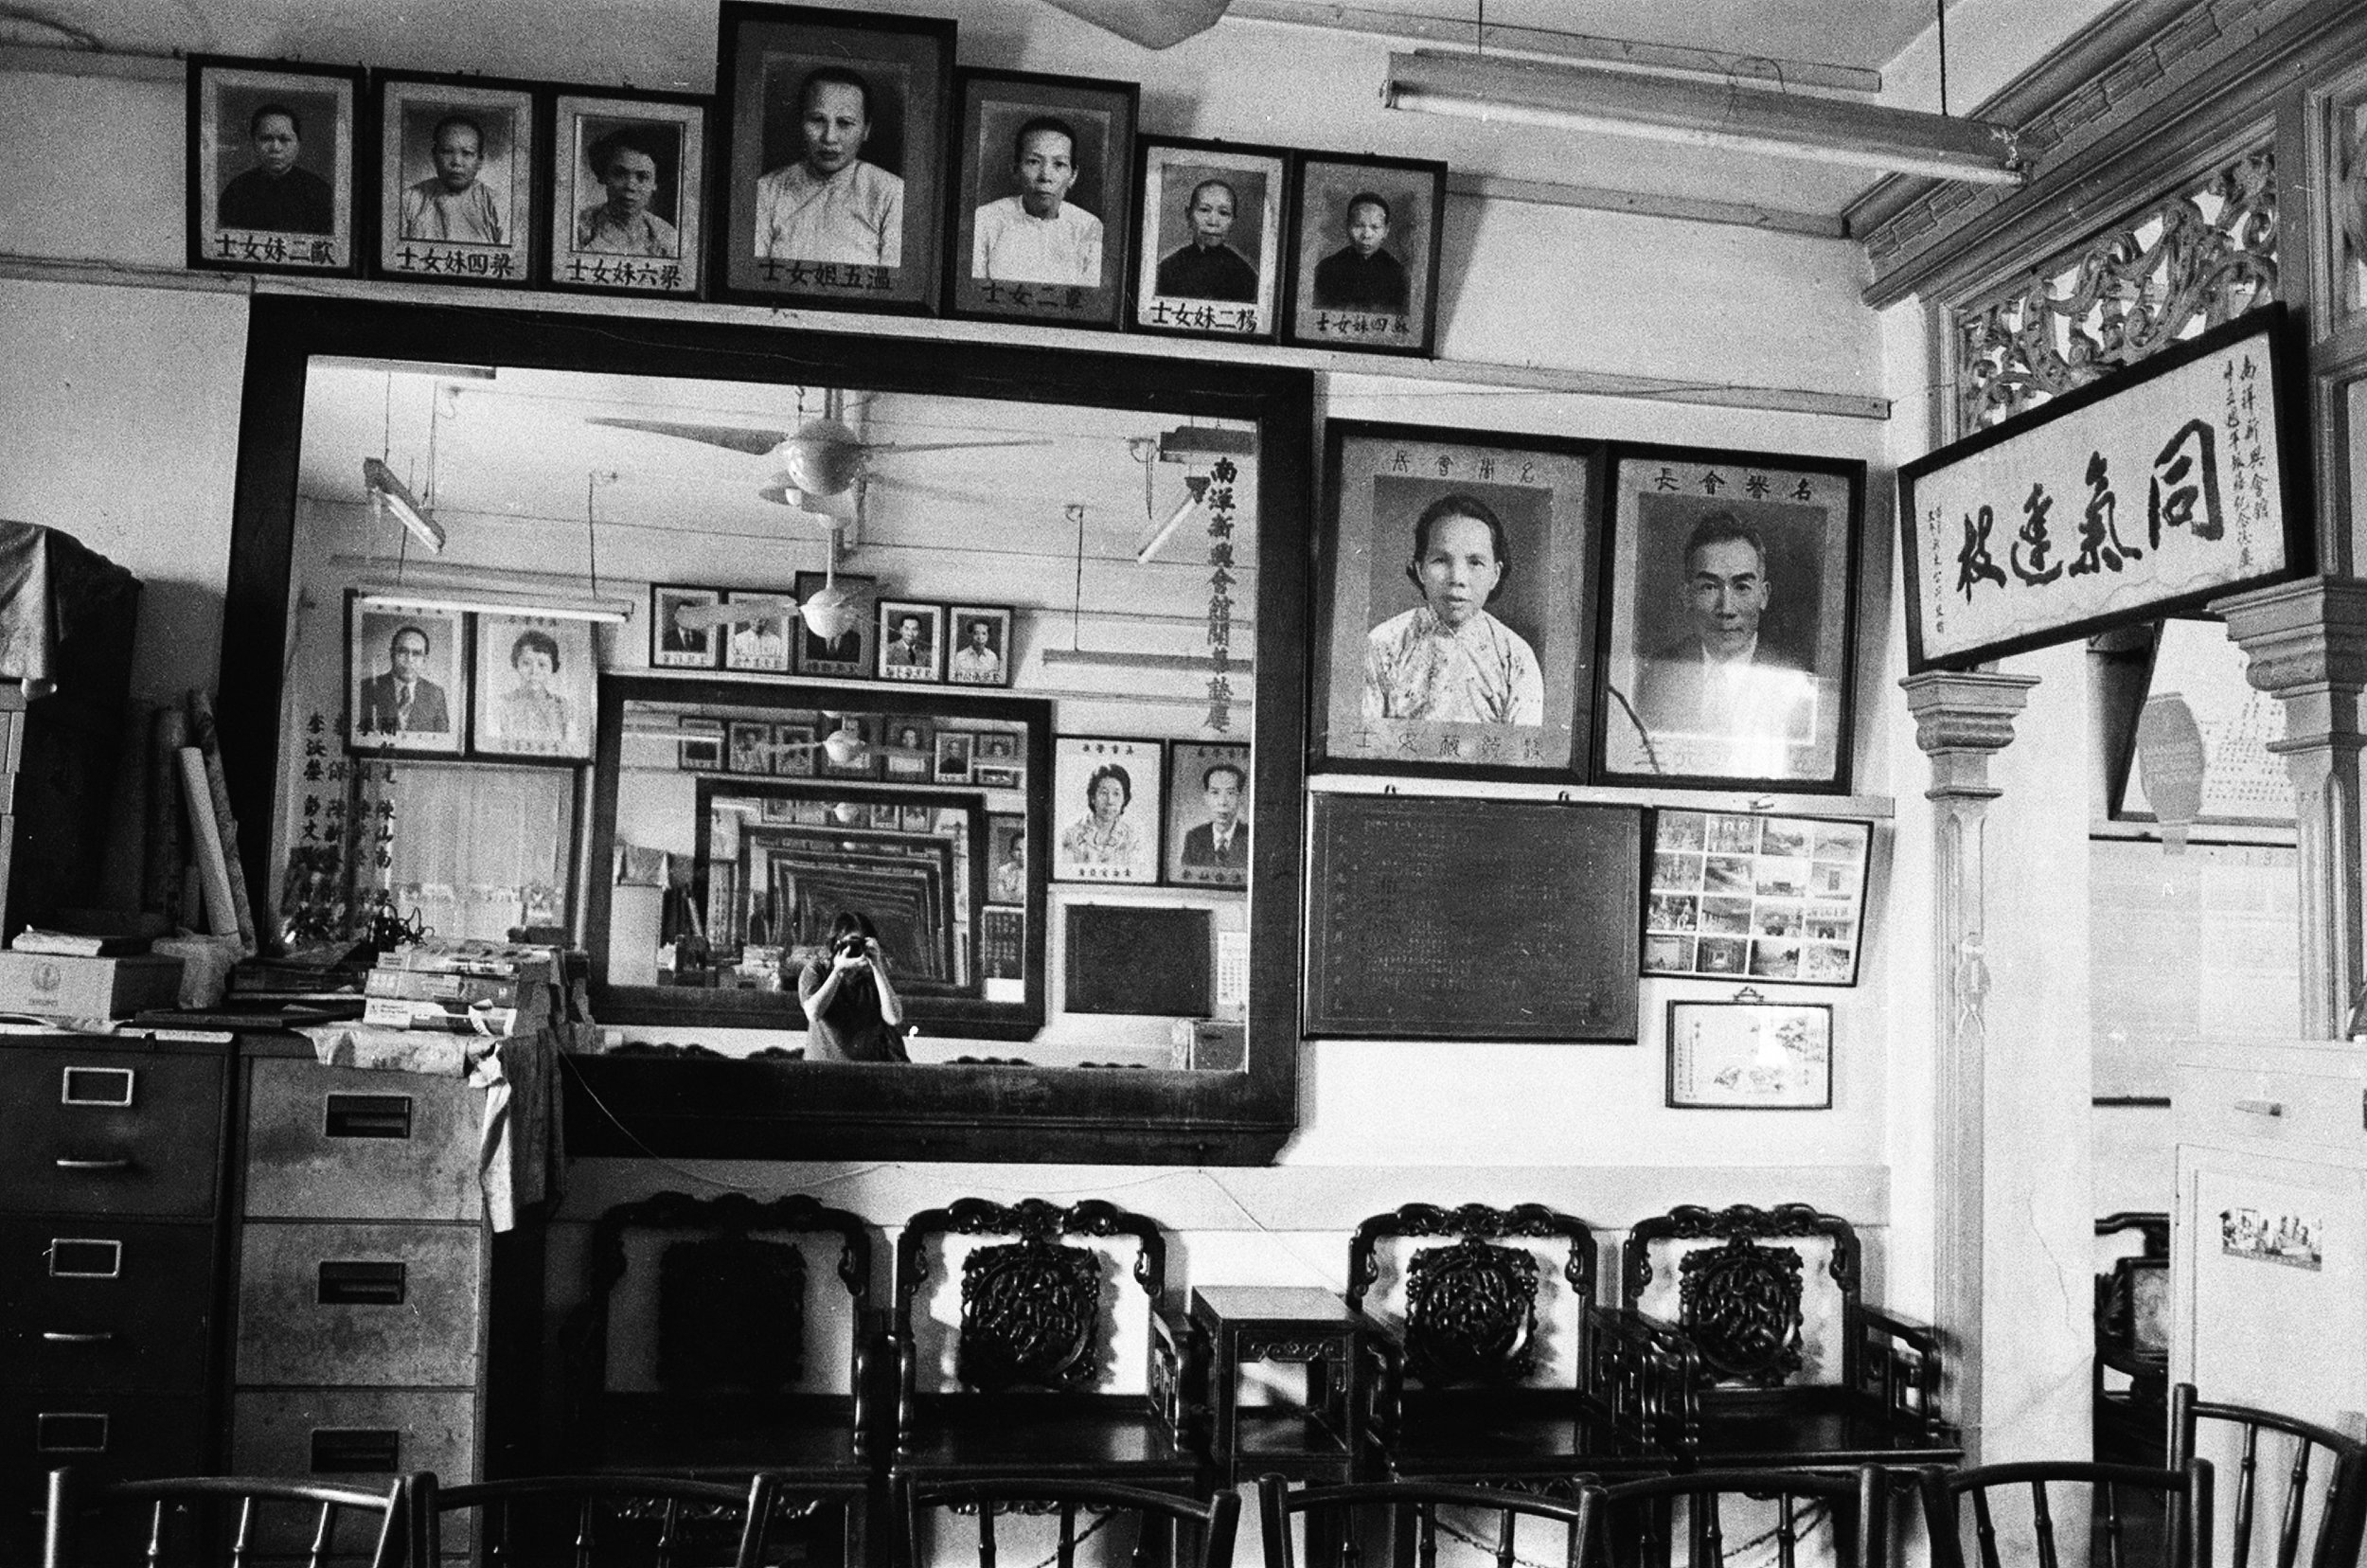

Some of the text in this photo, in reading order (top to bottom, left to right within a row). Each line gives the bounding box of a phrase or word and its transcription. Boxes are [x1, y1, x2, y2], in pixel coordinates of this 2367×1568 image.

[397, 248, 513, 276] 梁四妹女士
[568, 259, 681, 290] 梁六妹女士
[1150, 300, 1258, 332] 楊二妹女士
[1656, 468, 1812, 500] 名譽會長
[1957, 419, 2223, 605] 同氣連枝
